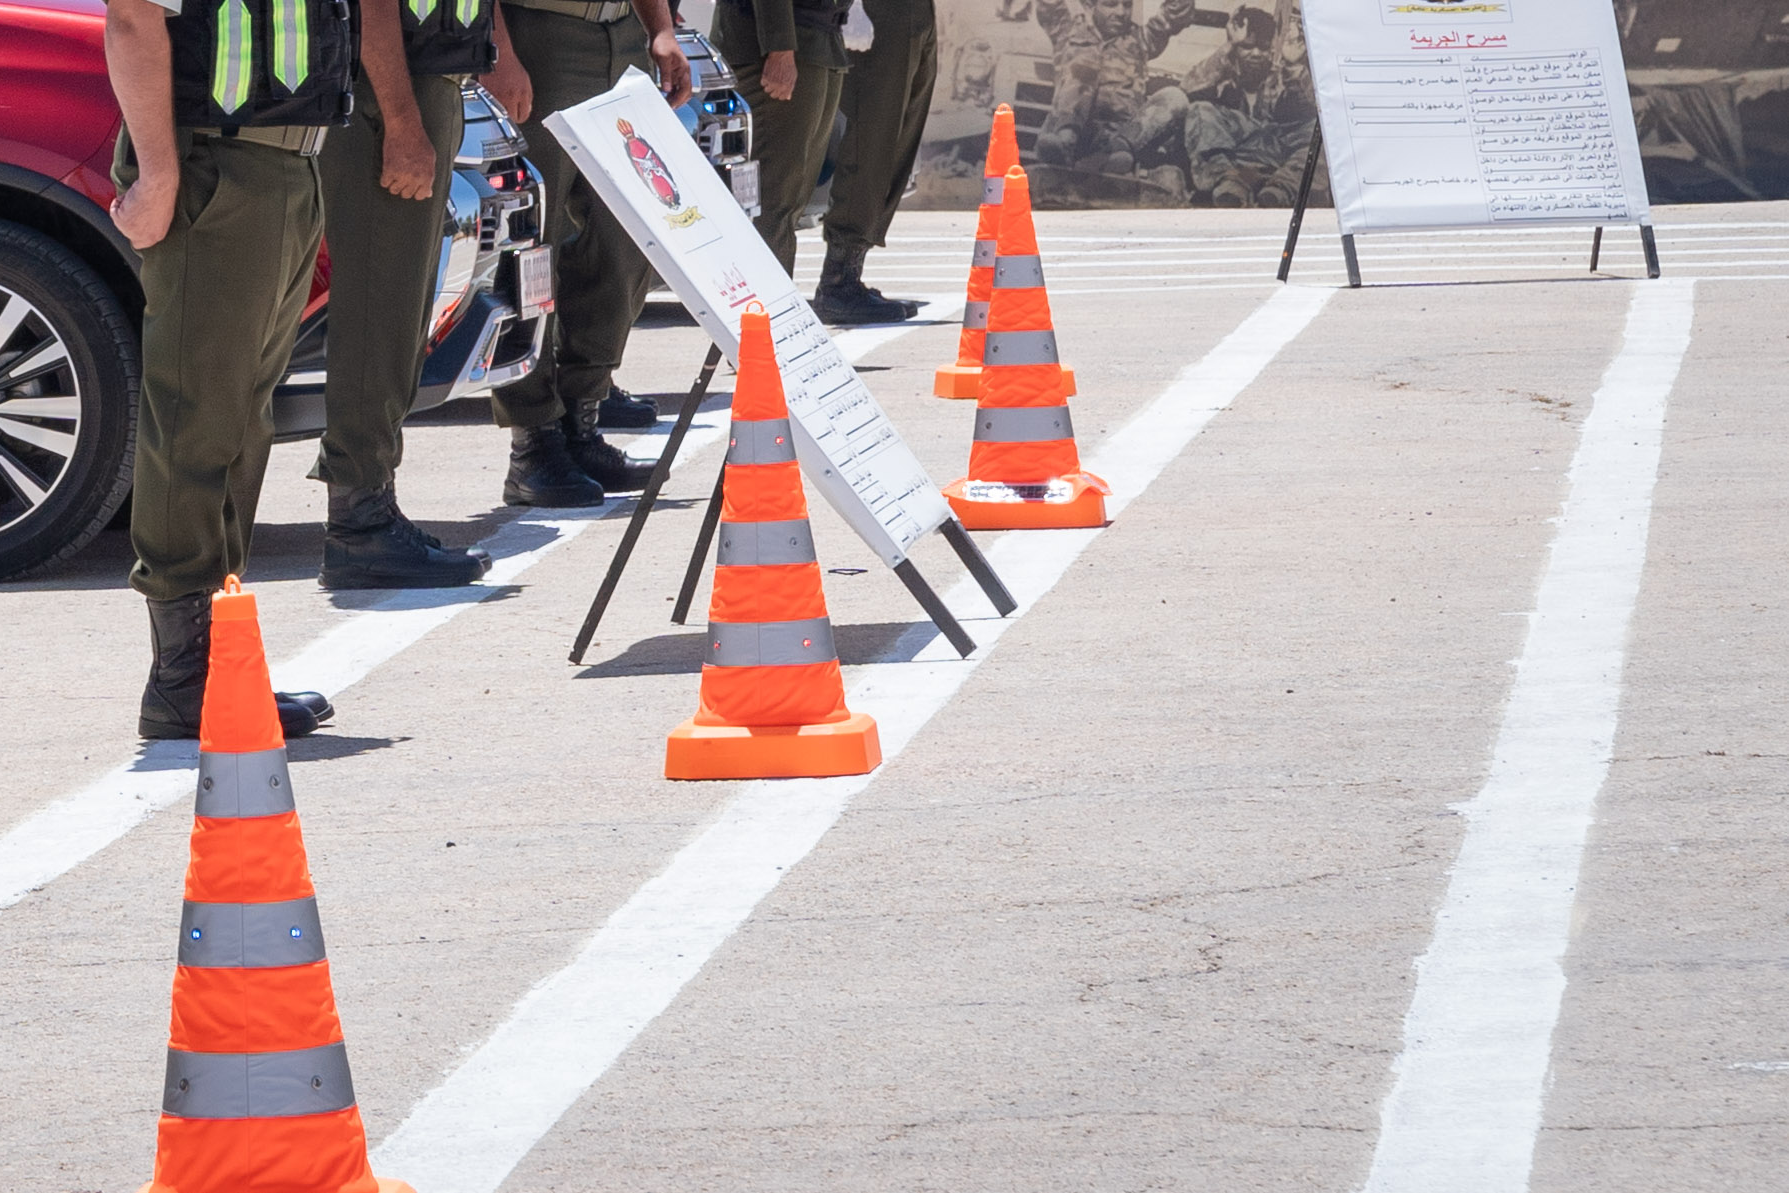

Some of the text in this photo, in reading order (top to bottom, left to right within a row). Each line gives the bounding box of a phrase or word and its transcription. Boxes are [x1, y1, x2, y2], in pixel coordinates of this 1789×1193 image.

[1410, 28, 1507, 47] مسرح الجريمة
[1513, 64, 1540, 72] الجريمة
[1544, 62, 1560, 72] موقع
[1419, 78, 1439, 86] مسرح
[1538, 93, 1558, 103] الموقع
[1566, 112, 1586, 122] الموقع
[1562, 132, 1582, 143] الموقع
[1597, 160, 1618, 171] الموقع
